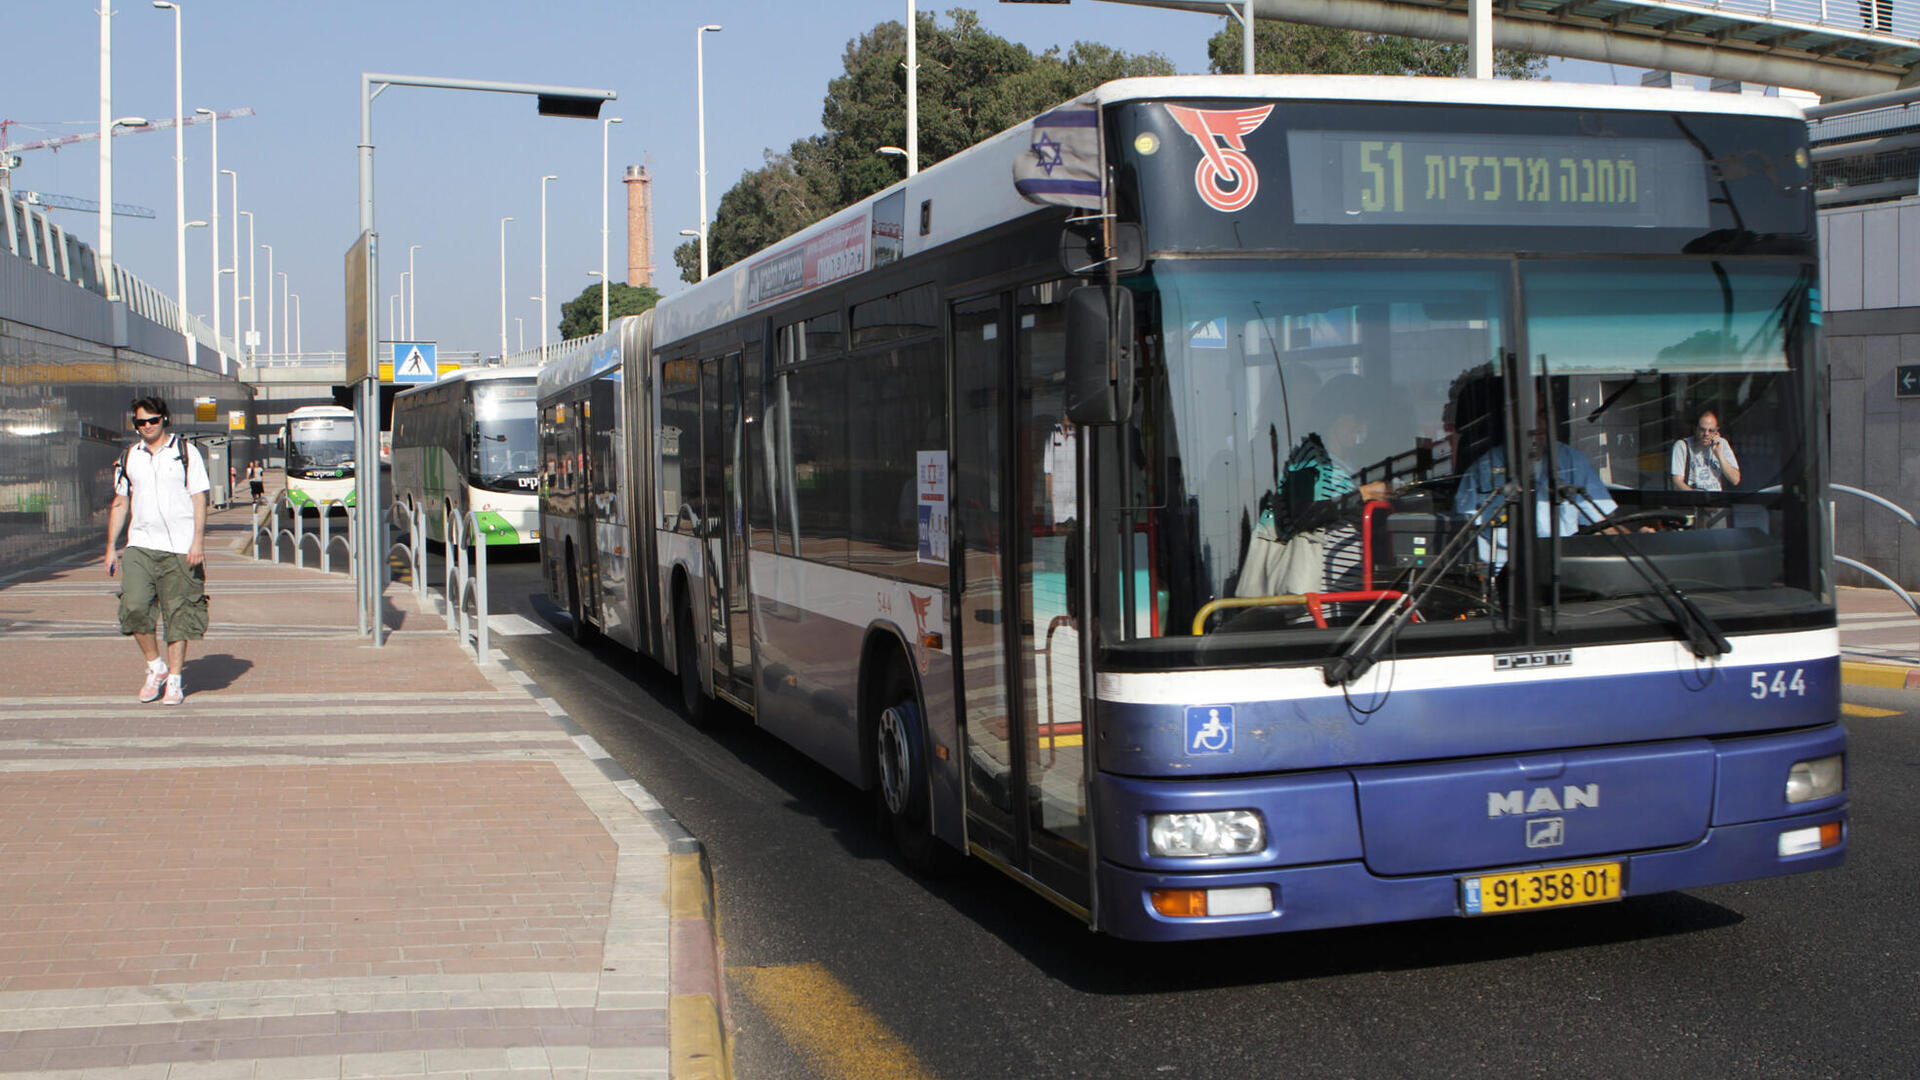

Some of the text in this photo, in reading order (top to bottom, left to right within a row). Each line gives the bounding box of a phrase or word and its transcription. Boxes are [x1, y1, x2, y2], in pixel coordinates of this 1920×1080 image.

[1361, 141, 1637, 213] תחנה מרכזית 51
[877, 591, 892, 616] 544
[1750, 668, 1806, 700] 544
[1487, 783, 1599, 818] MAN
